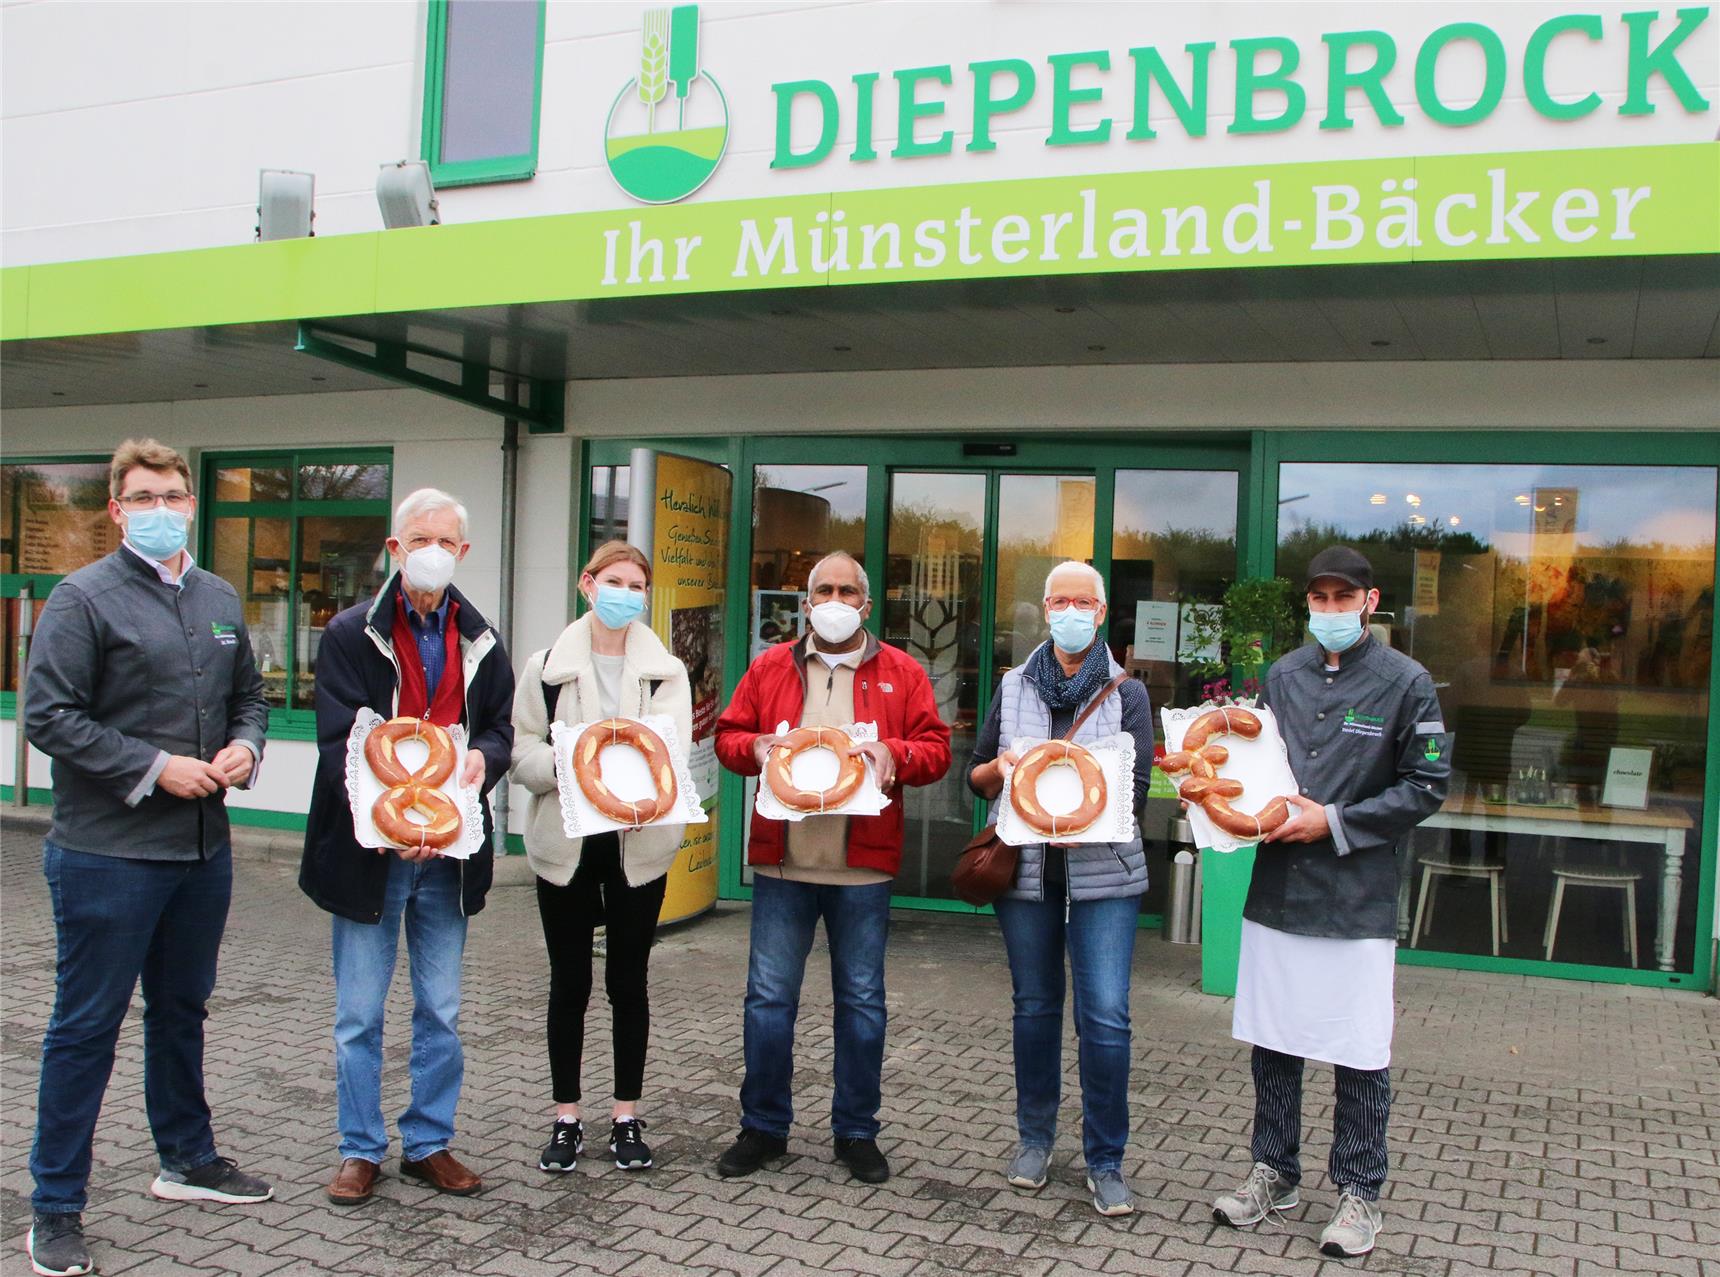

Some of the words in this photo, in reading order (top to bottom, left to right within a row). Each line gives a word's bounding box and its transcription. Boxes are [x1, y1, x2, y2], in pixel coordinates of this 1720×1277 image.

[770, 6, 1710, 170] DIEPENBROCK
[600, 219, 703, 286] Ihr
[731, 166, 1652, 280] Münsterland-Bäcker
